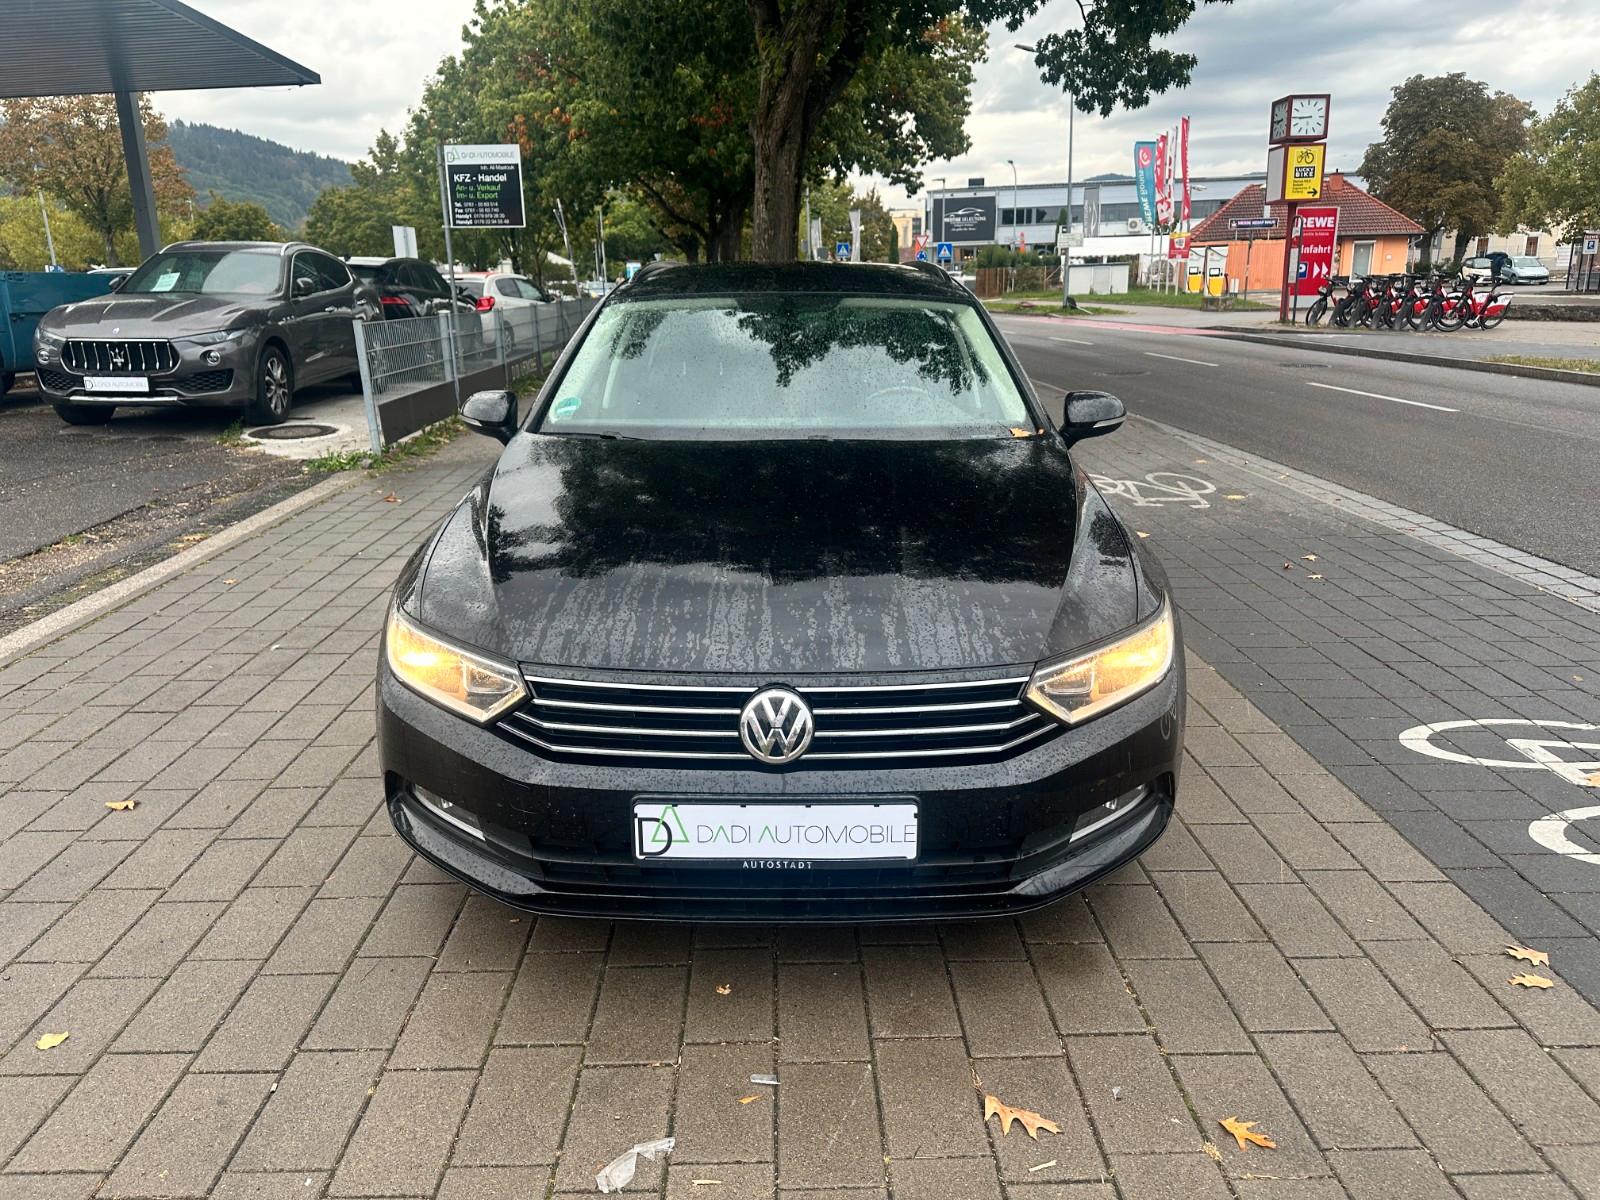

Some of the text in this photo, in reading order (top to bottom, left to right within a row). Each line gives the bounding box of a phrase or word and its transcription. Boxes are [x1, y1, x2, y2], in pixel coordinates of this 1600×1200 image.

[476, 151, 514, 159] AUTOMOBILE
[453, 173, 471, 182] KFZ
[478, 173, 507, 182] Handel
[476, 192, 498, 200] Export
[1298, 216, 1335, 228] REWE
[1301, 245, 1331, 254] infahrt
[697, 825, 917, 843] DADI AUTOMOBILE
[742, 861, 813, 869] AUTOSTADT
